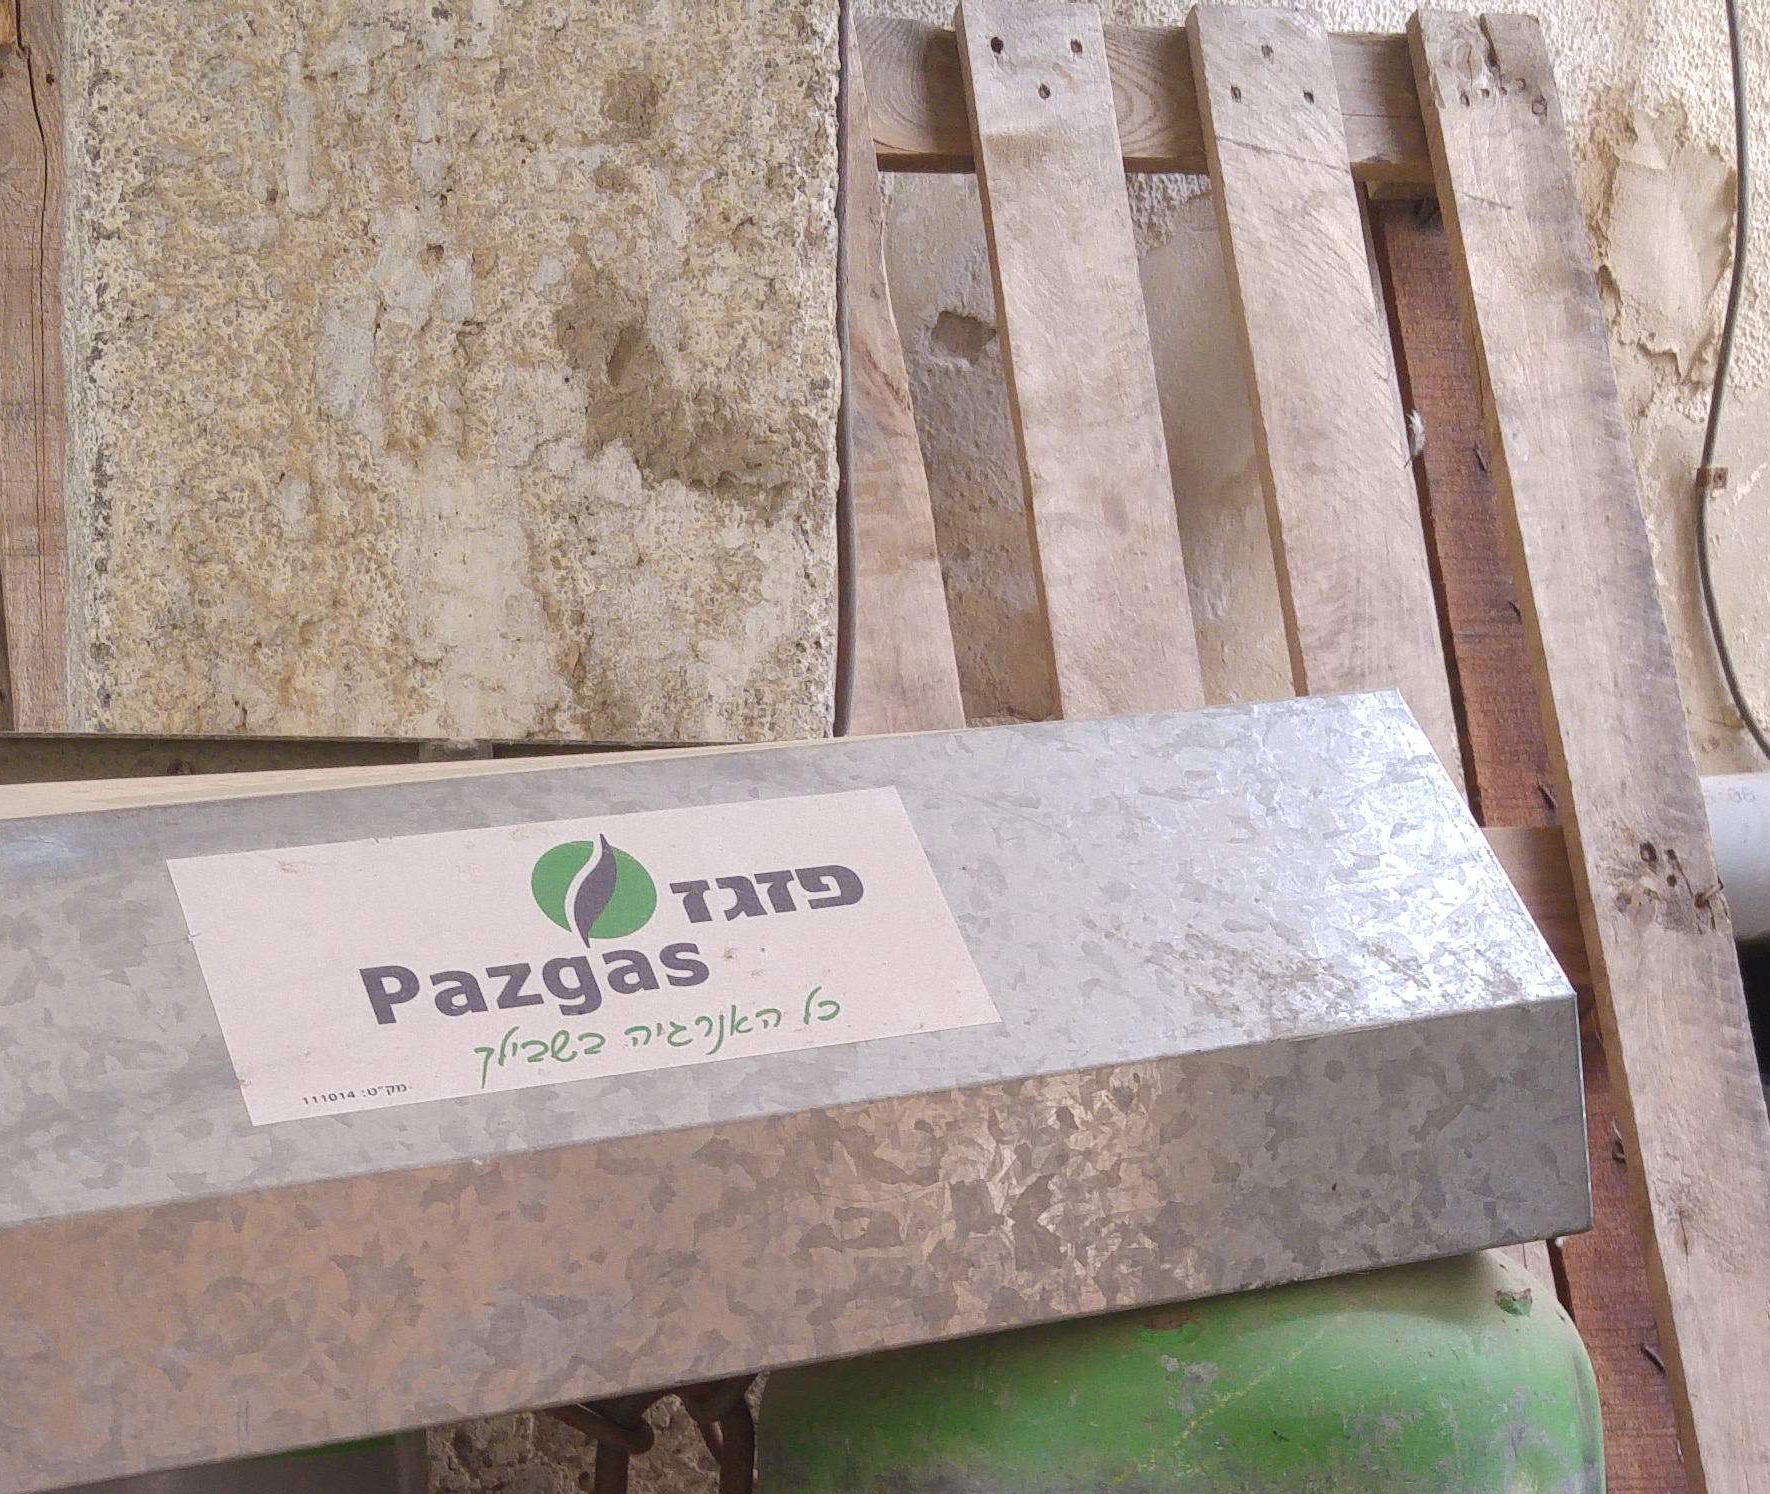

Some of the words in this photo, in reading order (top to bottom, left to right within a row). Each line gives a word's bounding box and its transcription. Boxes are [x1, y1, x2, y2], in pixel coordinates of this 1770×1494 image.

[669, 864, 865, 924] פזגז
[359, 941, 711, 1026] Pazgas
[803, 986, 841, 1025] כל
[474, 1025, 606, 1089] בשבילך
[624, 1004, 782, 1056] האנרגיה
[302, 1090, 356, 1105] 111014
